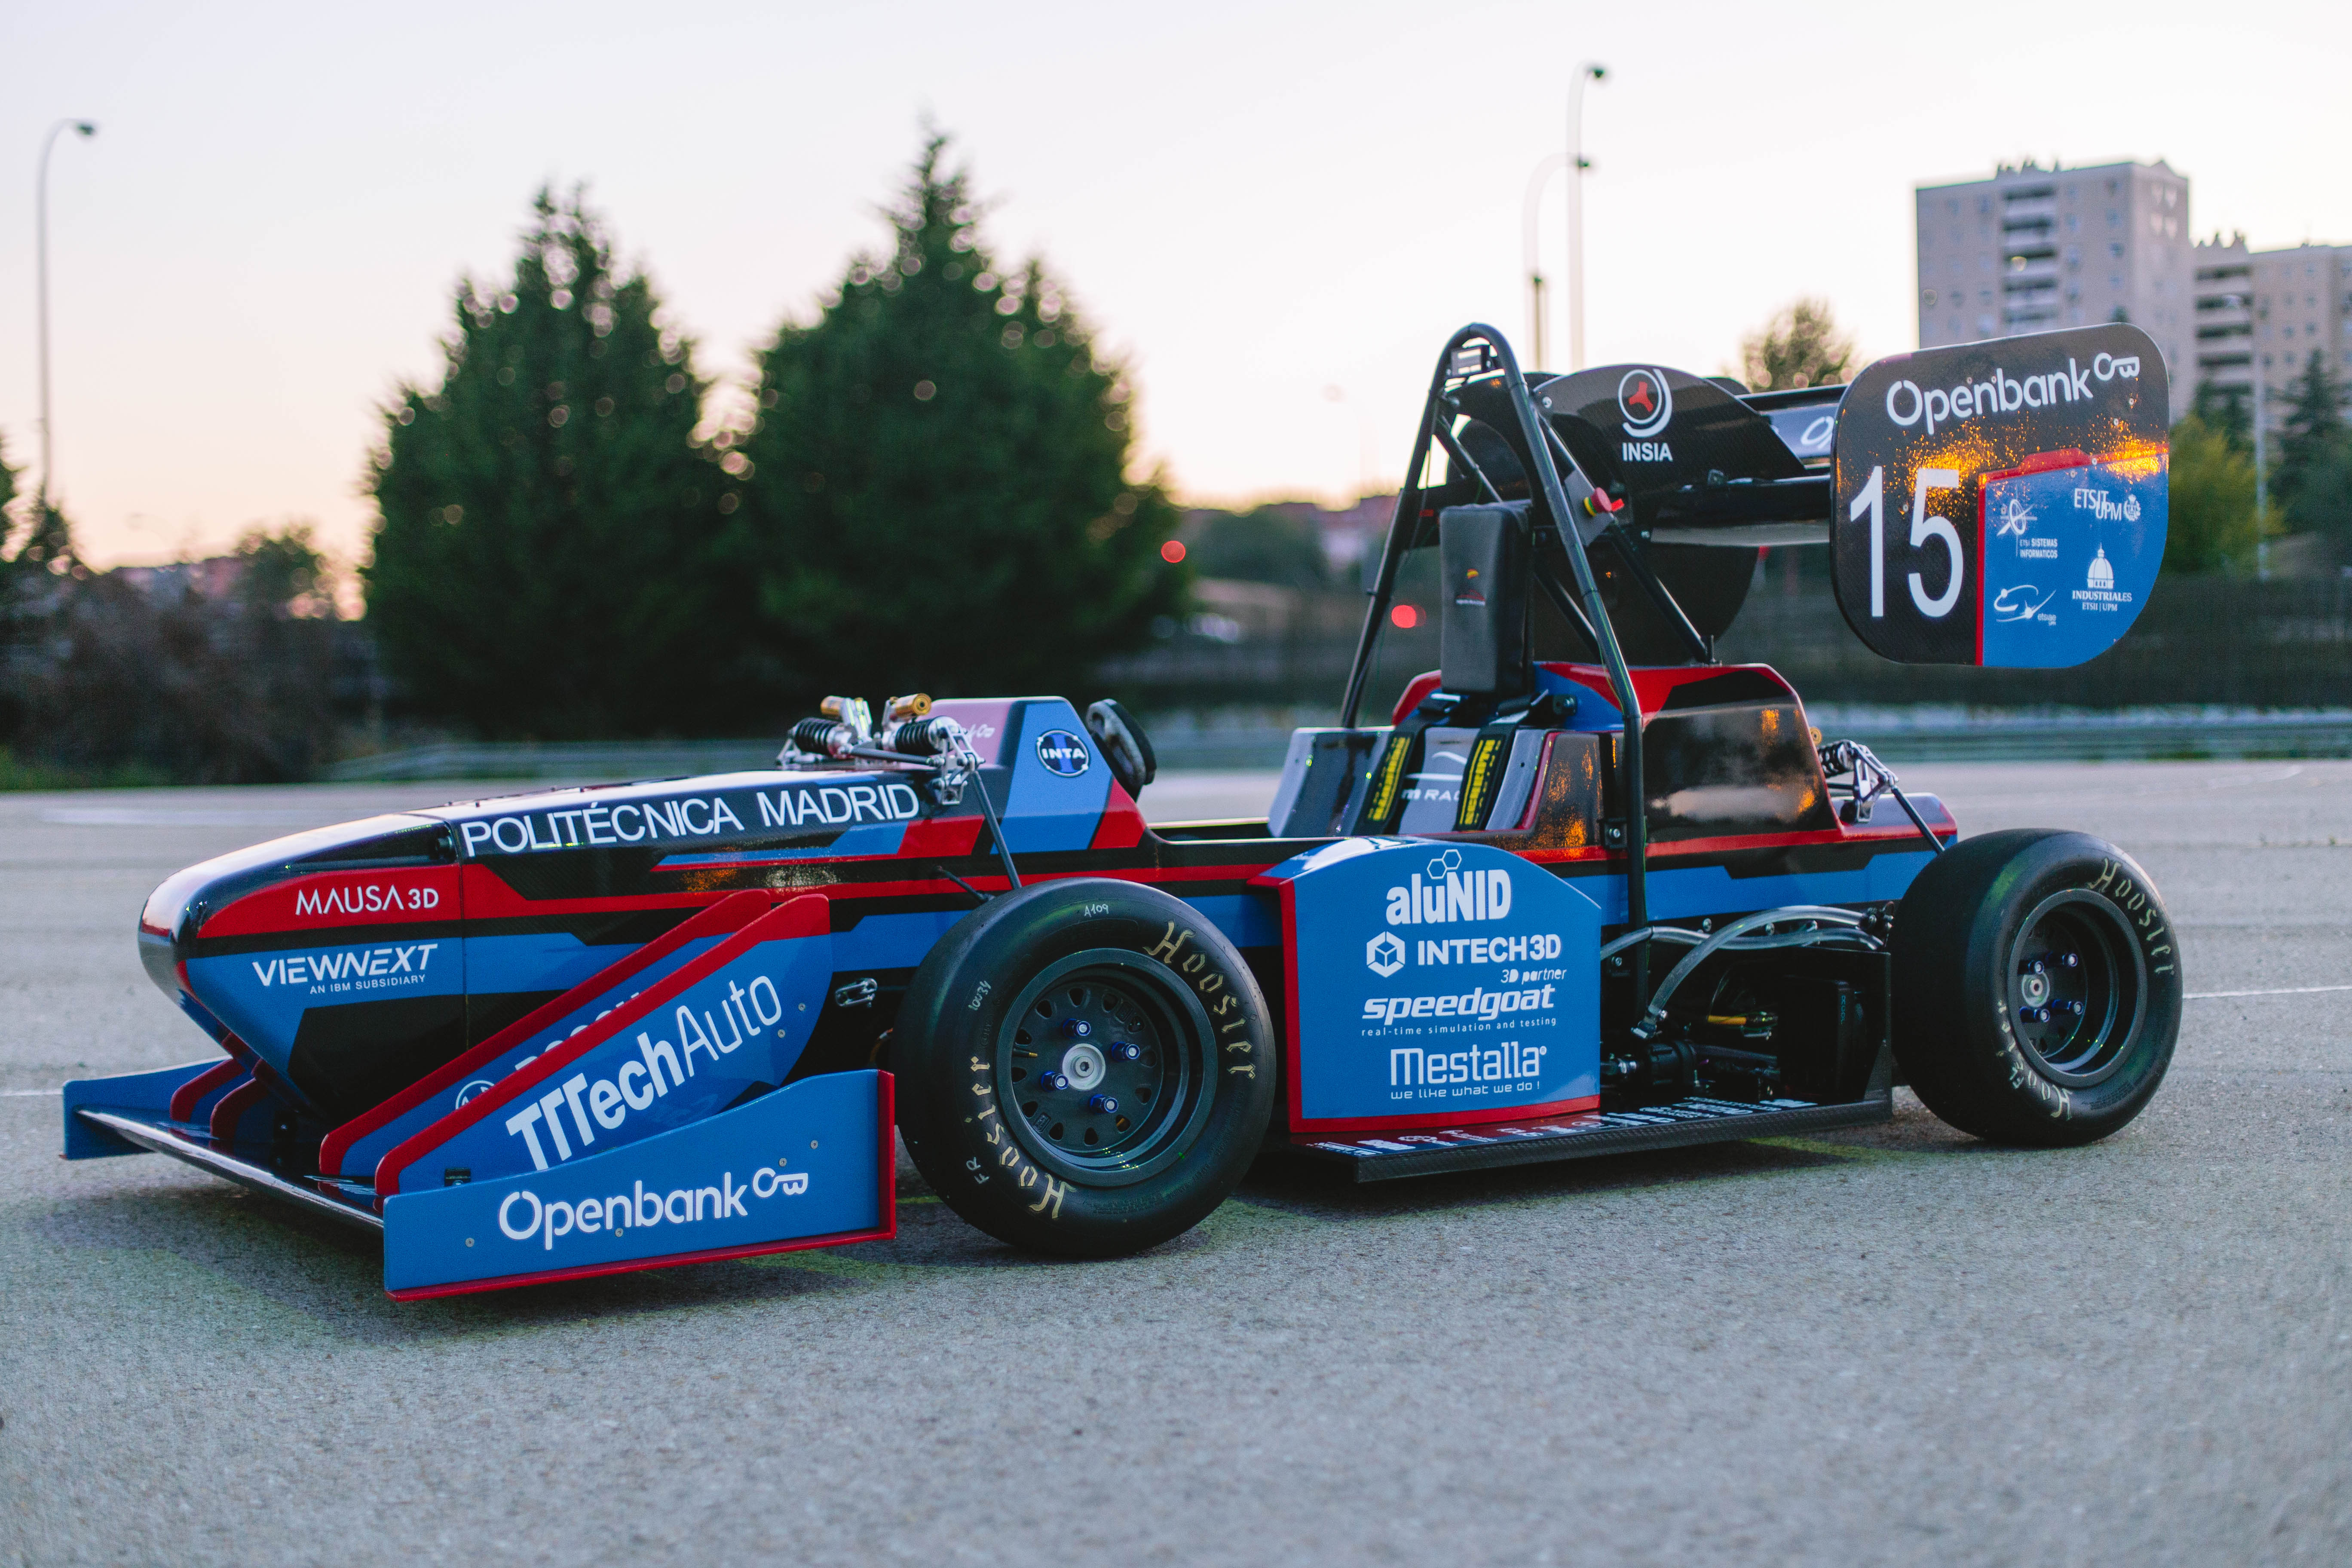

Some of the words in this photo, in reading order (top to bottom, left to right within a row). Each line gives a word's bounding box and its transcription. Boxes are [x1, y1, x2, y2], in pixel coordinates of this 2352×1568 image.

[1886, 358, 2093, 435] Openbank
[1622, 442, 1673, 462] INSIA
[2096, 501, 2122, 521] UPM
[1850, 466, 1963, 618] 15
[2031, 538, 2058, 547] SISTEMAS
[2072, 590, 2132, 602] INDUSTRIALES
[2102, 603, 2118, 611] UPM
[1041, 748, 1086, 759] INTA
[460, 797, 745, 858] POLITÉCNICA
[756, 784, 919, 827] MADRID
[295, 884, 404, 916] MAUSA
[408, 888, 439, 910] 3D
[252, 943, 438, 987] VIEWNEXT
[310, 986, 325, 995] AN
[330, 982, 351, 992] IBM
[355, 974, 426, 990] SUBSIDIARY
[1501, 969, 1519, 984] 3D
[1522, 968, 1567, 985] partner
[1143, 920, 1256, 1080] Hoosier
[1362, 984, 1555, 1025] speedgoat
[1362, 1026, 1421, 1036] real-time
[1428, 1022, 1491, 1034] simulation
[1497, 1020, 1515, 1029] and
[1520, 1017, 1557, 1028] testing
[1391, 1091, 1413, 1100] we
[1452, 1085, 1488, 1096] what
[1494, 1084, 1513, 1093] we
[964, 1056, 1077, 1219] Hoosier
[499, 1172, 748, 1251] Openbank
